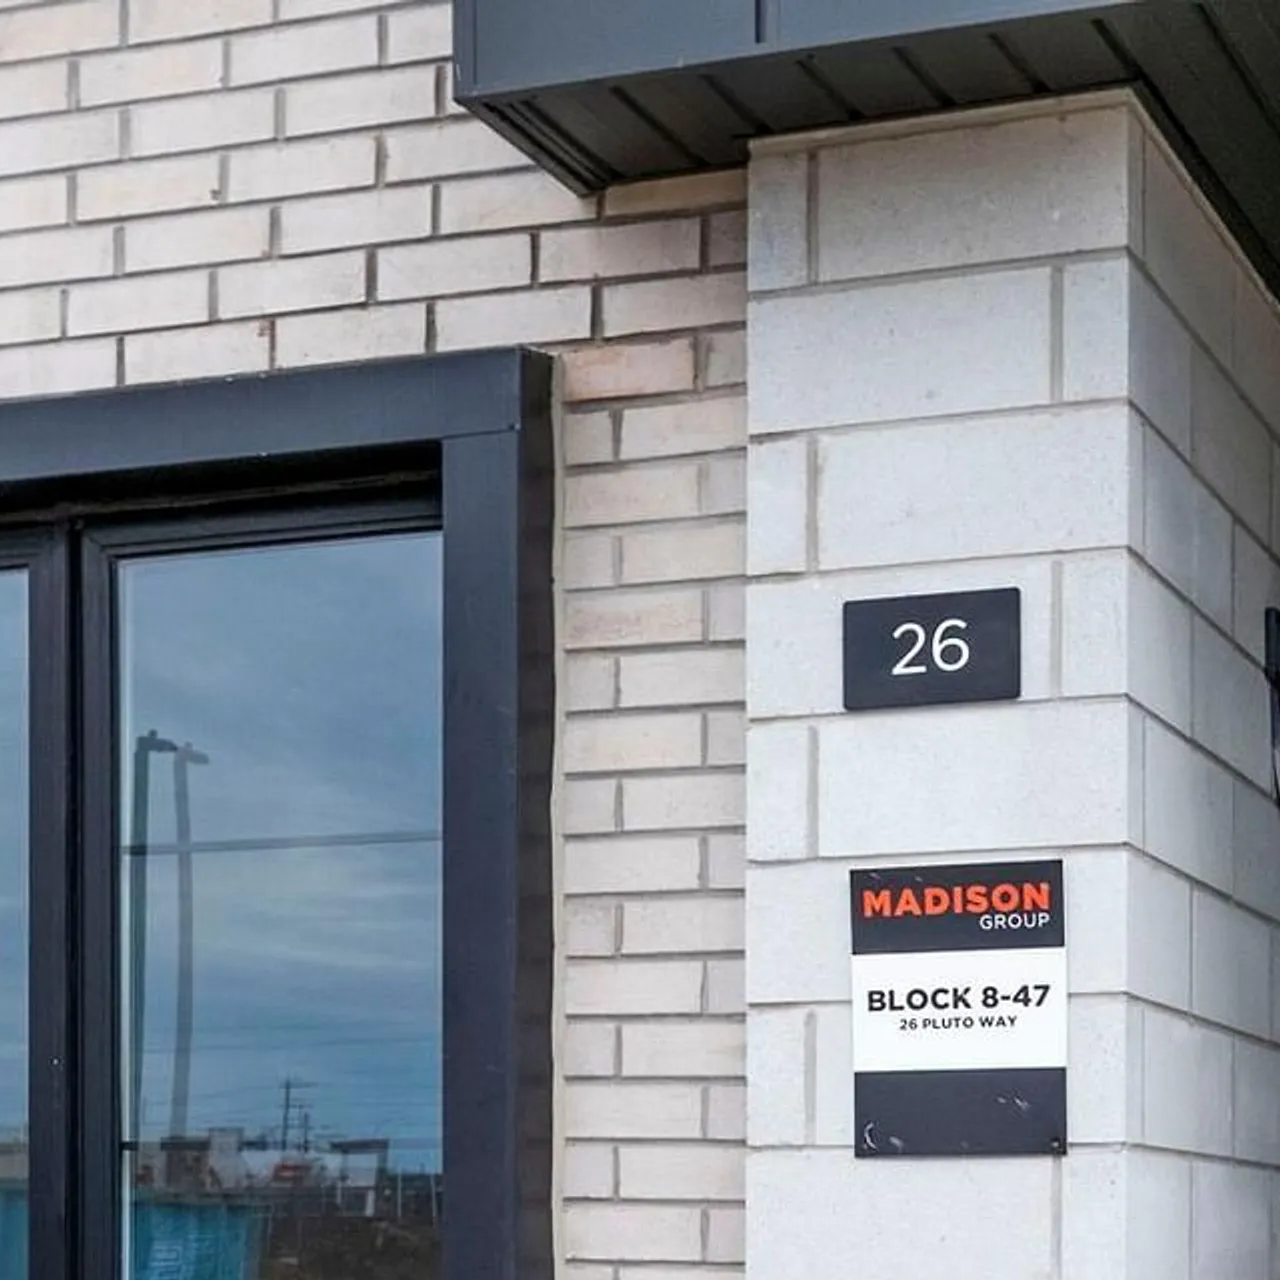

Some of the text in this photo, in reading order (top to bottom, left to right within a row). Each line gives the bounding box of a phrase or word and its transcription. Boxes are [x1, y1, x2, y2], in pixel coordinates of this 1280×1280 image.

[892, 618, 970, 675] 26
[863, 882, 1050, 918] MADISON
[979, 912, 1050, 930] GROUP
[867, 984, 1050, 1012] BLOCK 8-47
[899, 1015, 1018, 1031] 26 PLUTO WAY
